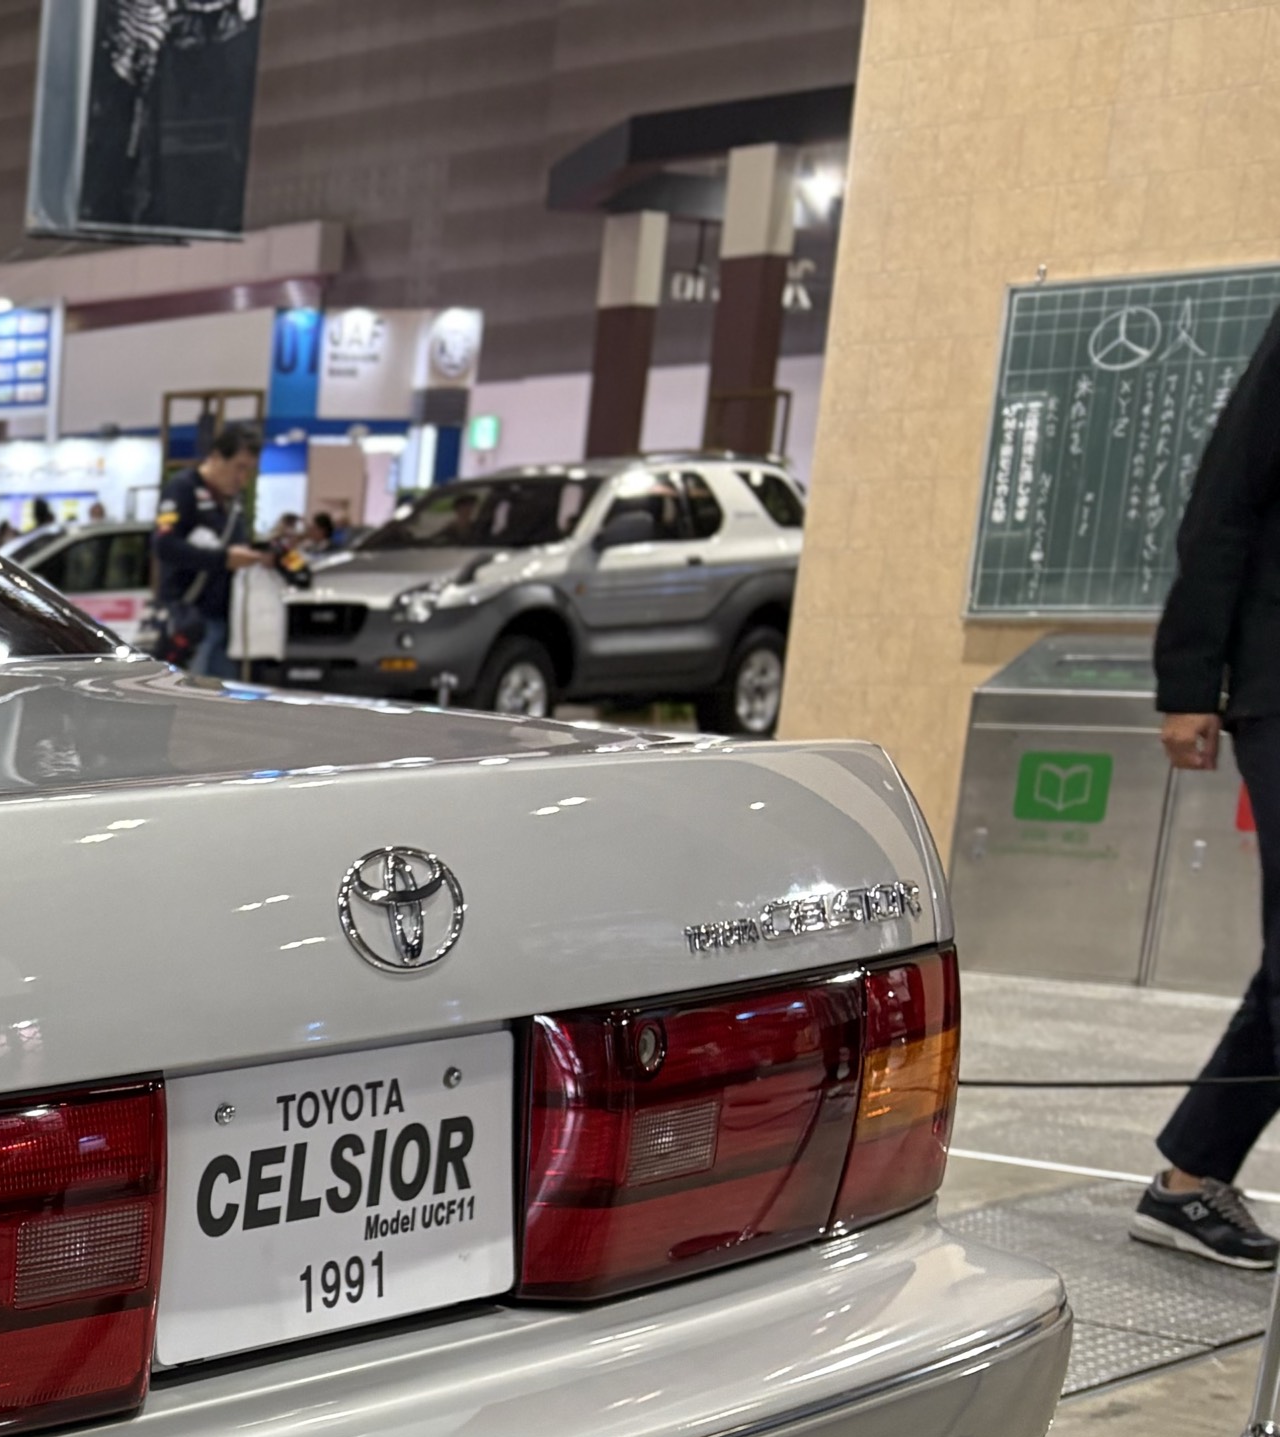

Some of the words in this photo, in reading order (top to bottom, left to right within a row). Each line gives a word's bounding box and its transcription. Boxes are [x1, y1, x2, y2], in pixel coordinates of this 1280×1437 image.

[759, 881, 922, 941] CELSIOR
[276, 1078, 405, 1132] TOYOTA
[196, 1115, 474, 1238] CELSIOR
[364, 1207, 416, 1241] Model
[421, 1196, 475, 1229] UCF11
[299, 1250, 384, 1313] 1991
